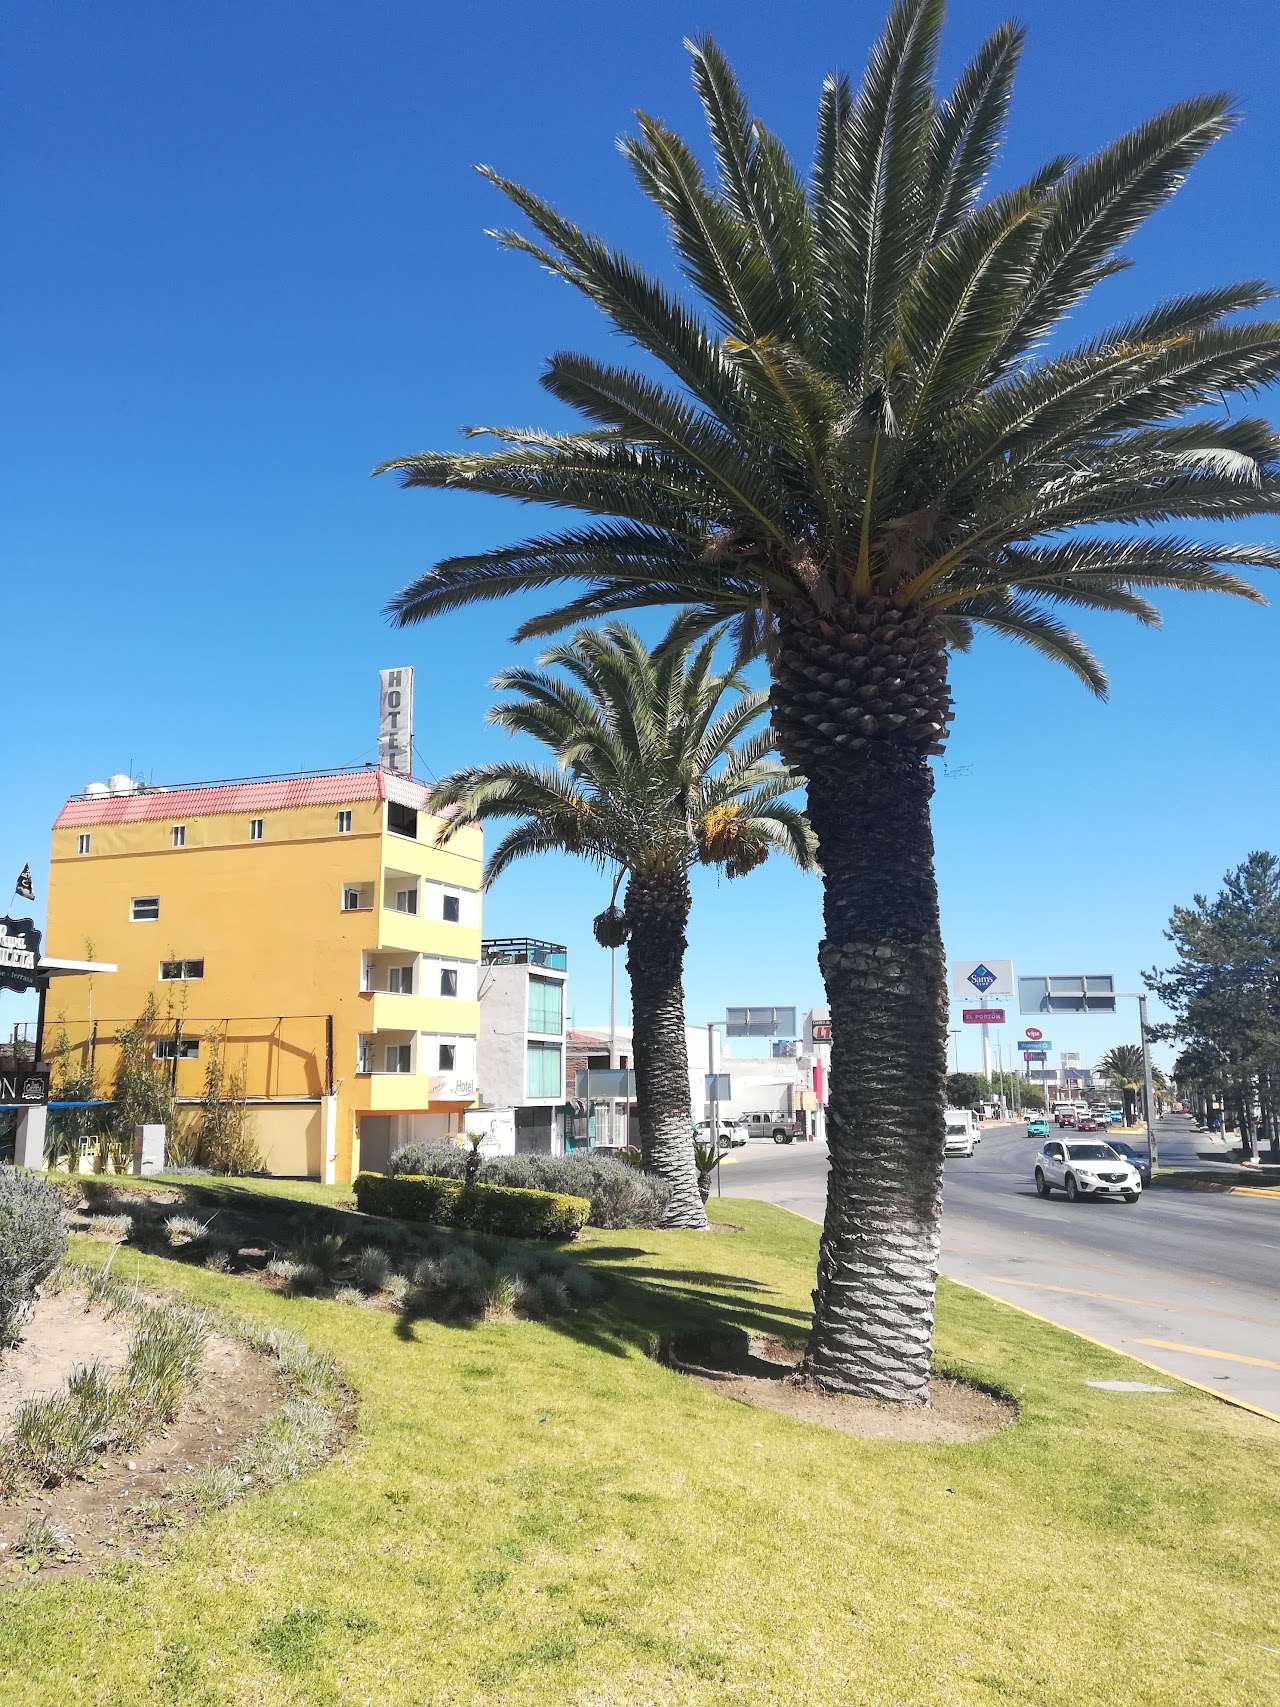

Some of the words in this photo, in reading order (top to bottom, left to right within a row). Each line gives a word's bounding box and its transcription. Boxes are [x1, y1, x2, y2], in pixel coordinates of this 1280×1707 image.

[387, 671, 402, 770] HOTEL
[971, 974, 994, 984] Sam's
[0, 1077, 17, 1099] N
[456, 1079, 474, 1093] Hotel
